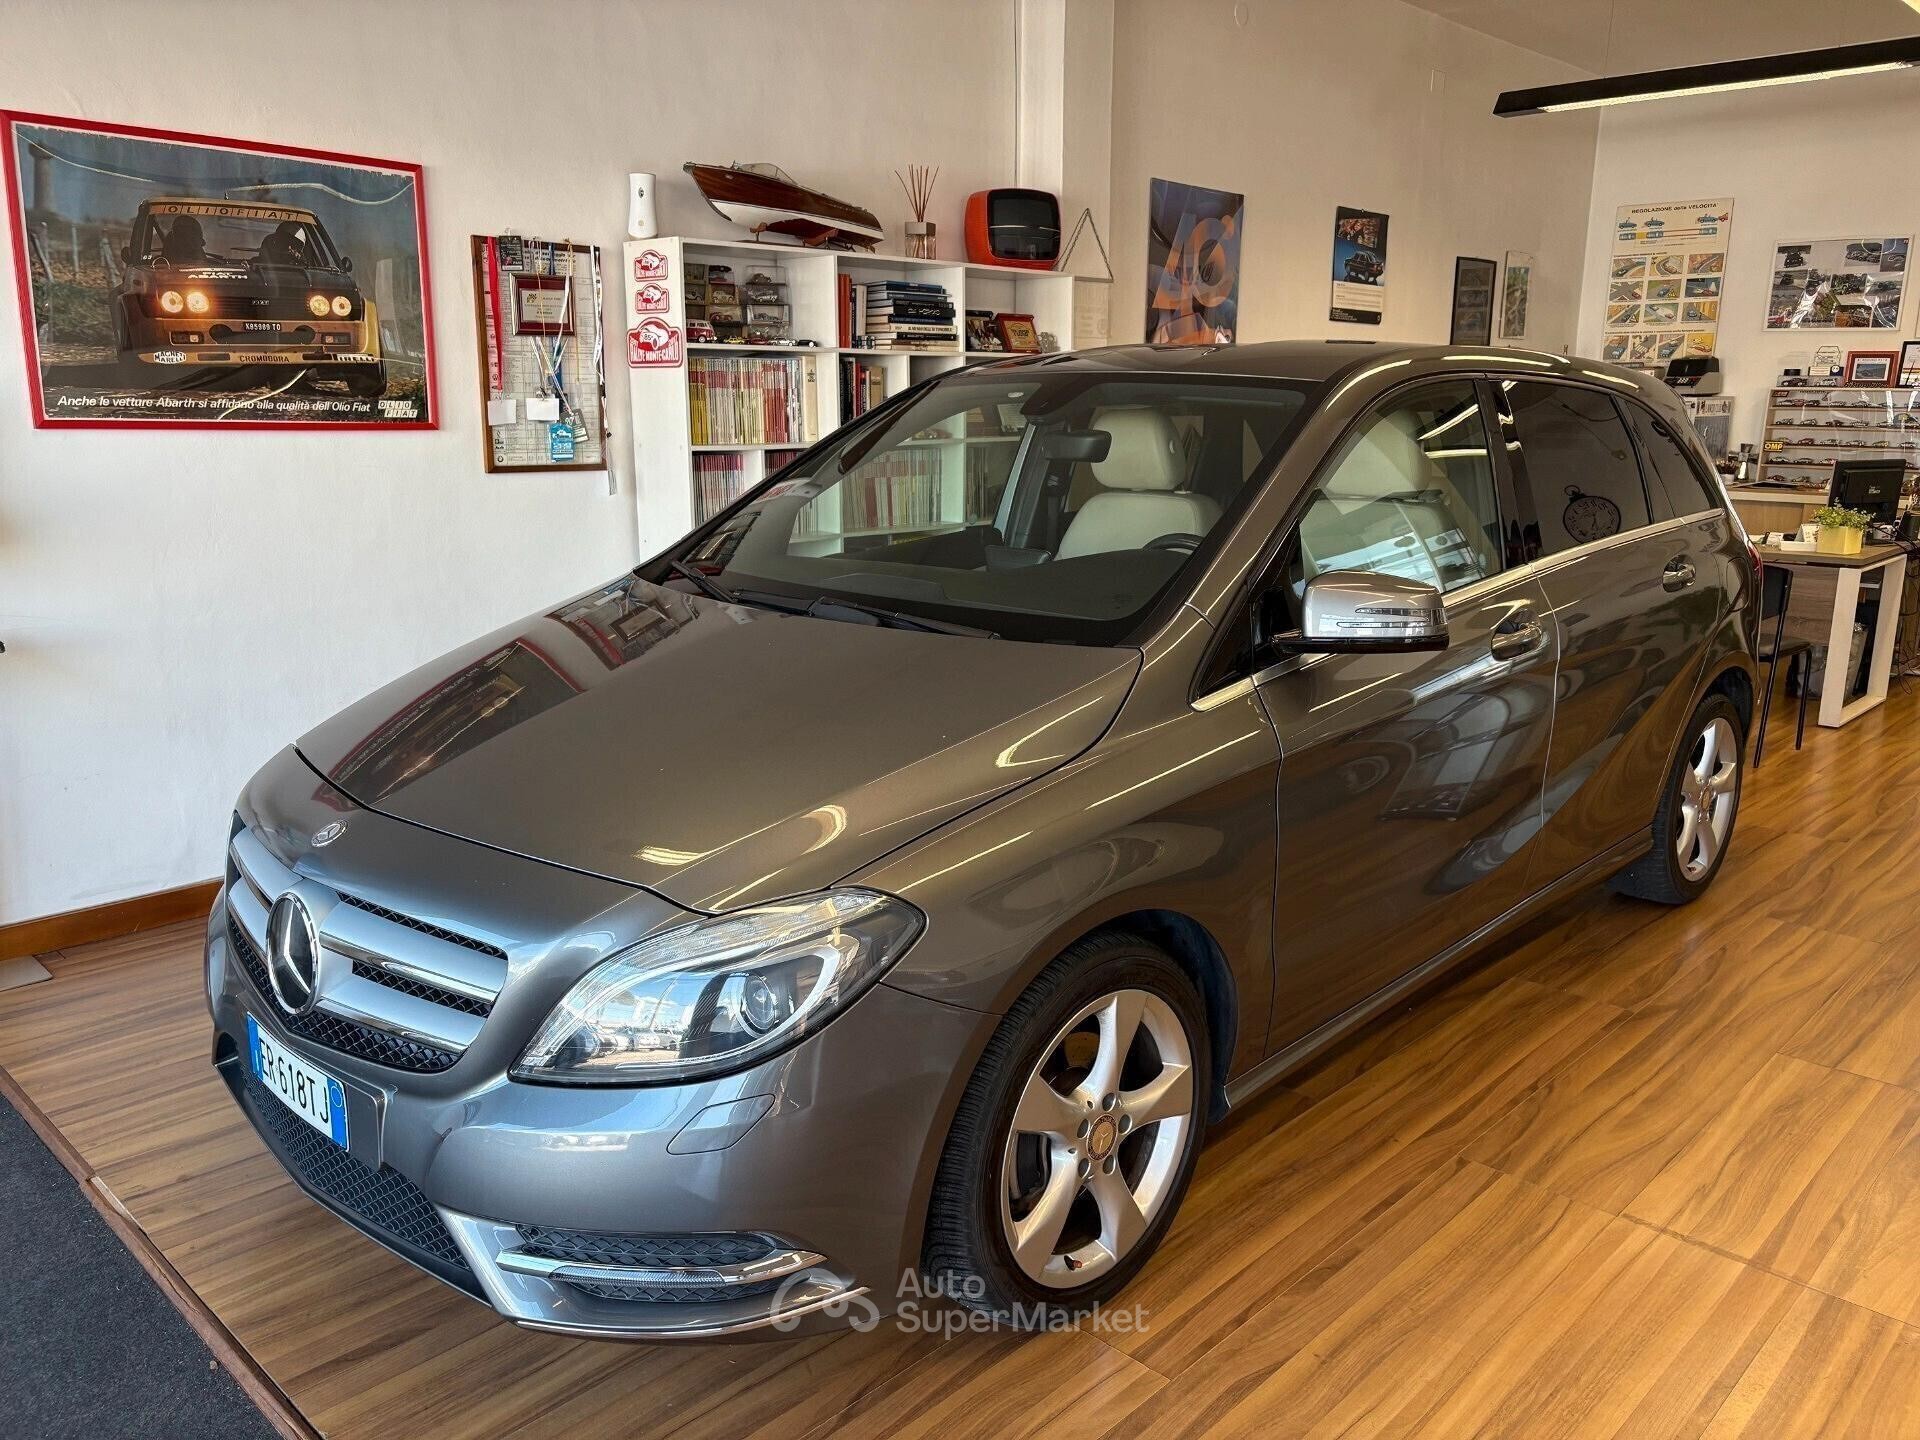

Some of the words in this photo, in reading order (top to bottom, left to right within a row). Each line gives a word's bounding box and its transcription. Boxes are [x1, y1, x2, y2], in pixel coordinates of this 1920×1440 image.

[1631, 206, 1673, 214] REGOLAZIONE
[57, 395, 97, 406] Anche
[100, 396, 109, 406] le
[113, 397, 153, 407] vetture
[156, 397, 194, 408] Abarth
[198, 398, 206, 408] si
[210, 397, 254, 409] affidano
[256, 400, 274, 410] alla
[276, 399, 310, 411] qualità
[352, 402, 371, 412] Fiat
[378, 400, 411, 410] OLIO
[384, 409, 417, 418] FIAT
[1764, 442, 1783, 450] OMP
